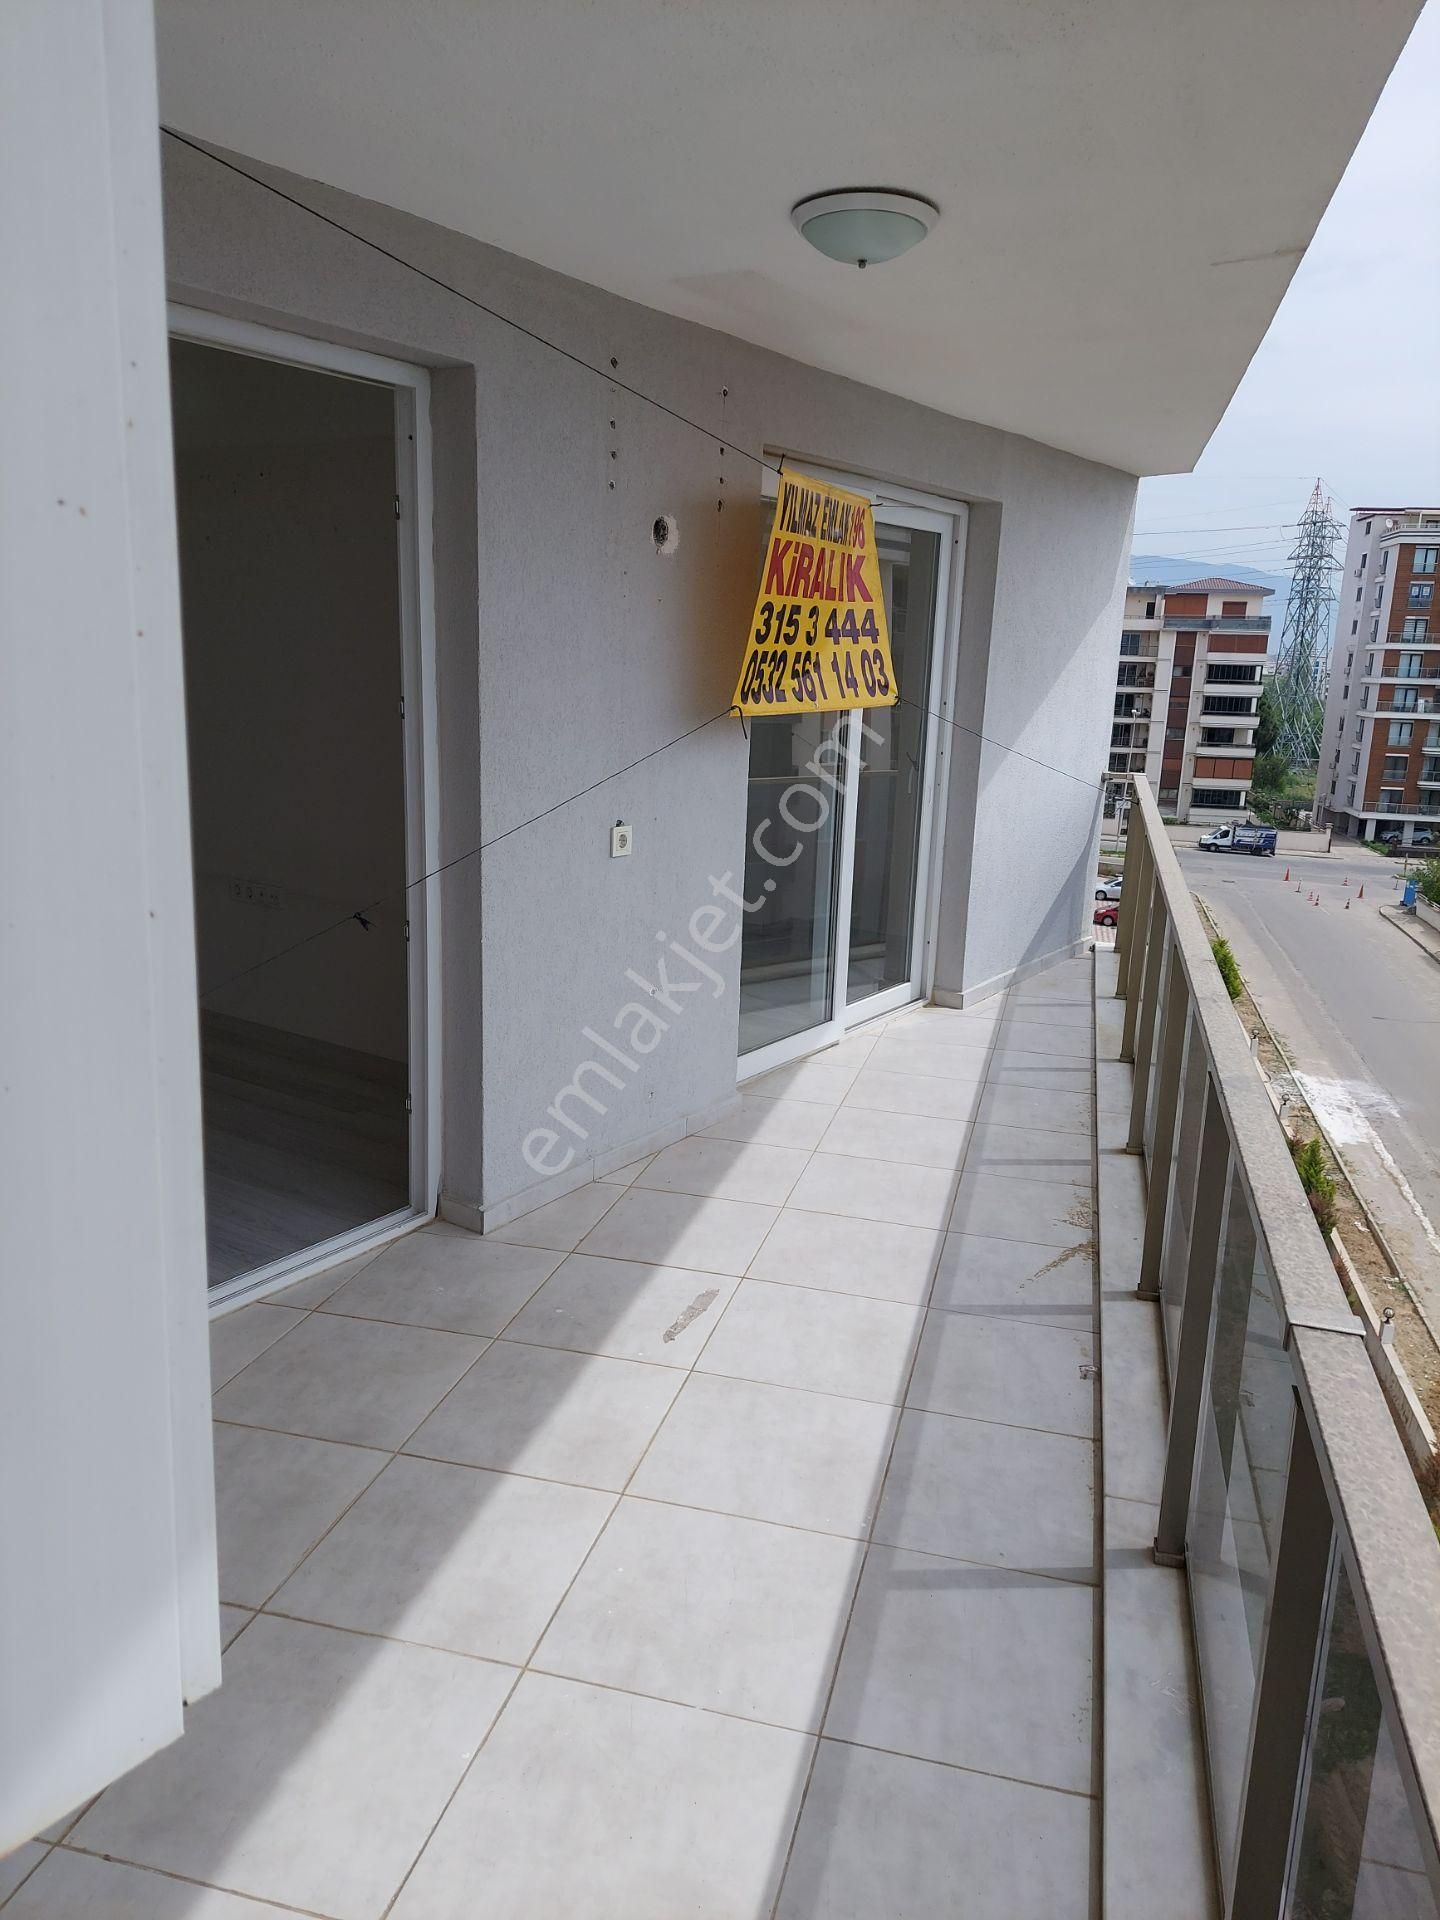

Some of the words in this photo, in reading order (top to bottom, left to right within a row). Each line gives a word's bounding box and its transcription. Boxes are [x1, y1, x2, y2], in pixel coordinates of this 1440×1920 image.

[779, 482, 821, 538] YILMAZ
[820, 496, 852, 546] EMLAK
[755, 601, 801, 645] 315
[805, 605, 820, 646] 3
[825, 608, 879, 645] 444
[740, 650, 787, 705] 0532
[791, 649, 828, 703] 561
[831, 652, 859, 699] 14
[861, 649, 890, 698] 03
